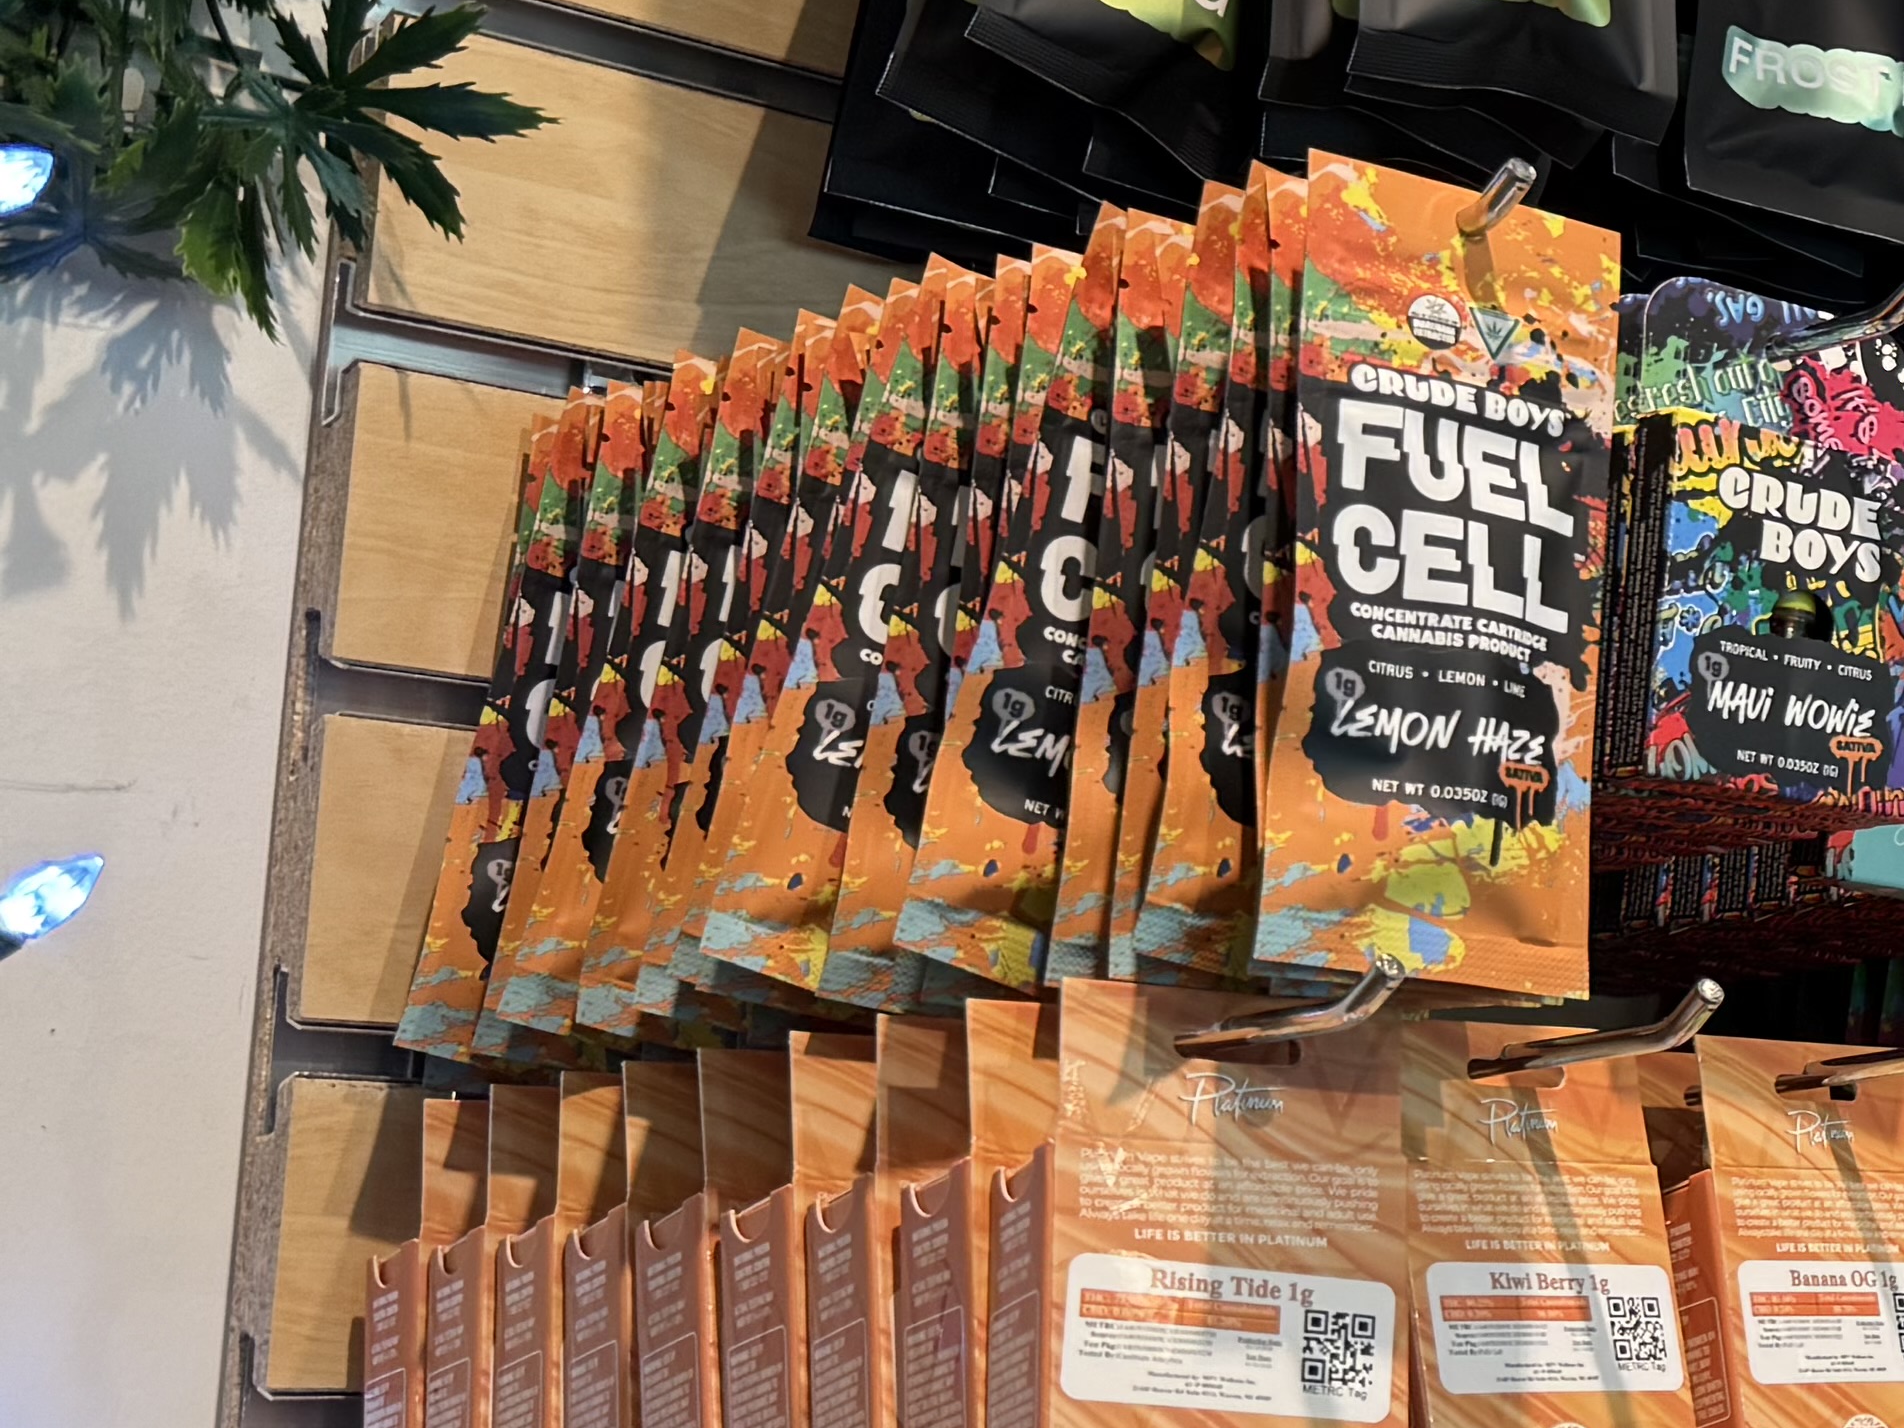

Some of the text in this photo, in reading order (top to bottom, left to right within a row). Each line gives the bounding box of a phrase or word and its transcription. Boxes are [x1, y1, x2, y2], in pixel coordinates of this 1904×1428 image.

[1350, 361, 1566, 437] CRUDE BOYS
[1336, 396, 1575, 538] FUEL
[1718, 466, 1882, 540] CRUDE
[1331, 502, 1569, 634] CELL
[1760, 519, 1881, 583] BOYS
[1350, 600, 1548, 653] CONCENTRATE CARTRIDGE
[1371, 623, 1531, 662] CANNABIS PRODUCT
[1368, 659, 1486, 688] CITRUS LEMON
[1719, 639, 1872, 681] TROPICAL FRUITY CITRUS
[1331, 695, 1545, 765] LEMON HAZE
[1371, 777, 1425, 797] NET WT
[1179, 1073, 1291, 1126] Platinum
[1134, 1228, 1328, 1248] LIFE IS BETTER IN PLATINUM
[1150, 1269, 1314, 1307] Rising Tide 1g
[1490, 1272, 1610, 1295] Kiwi Berry 1g
[1789, 1268, 1899, 1292] Banana OG 1g
[1302, 1384, 1368, 1401] METRC Tag
